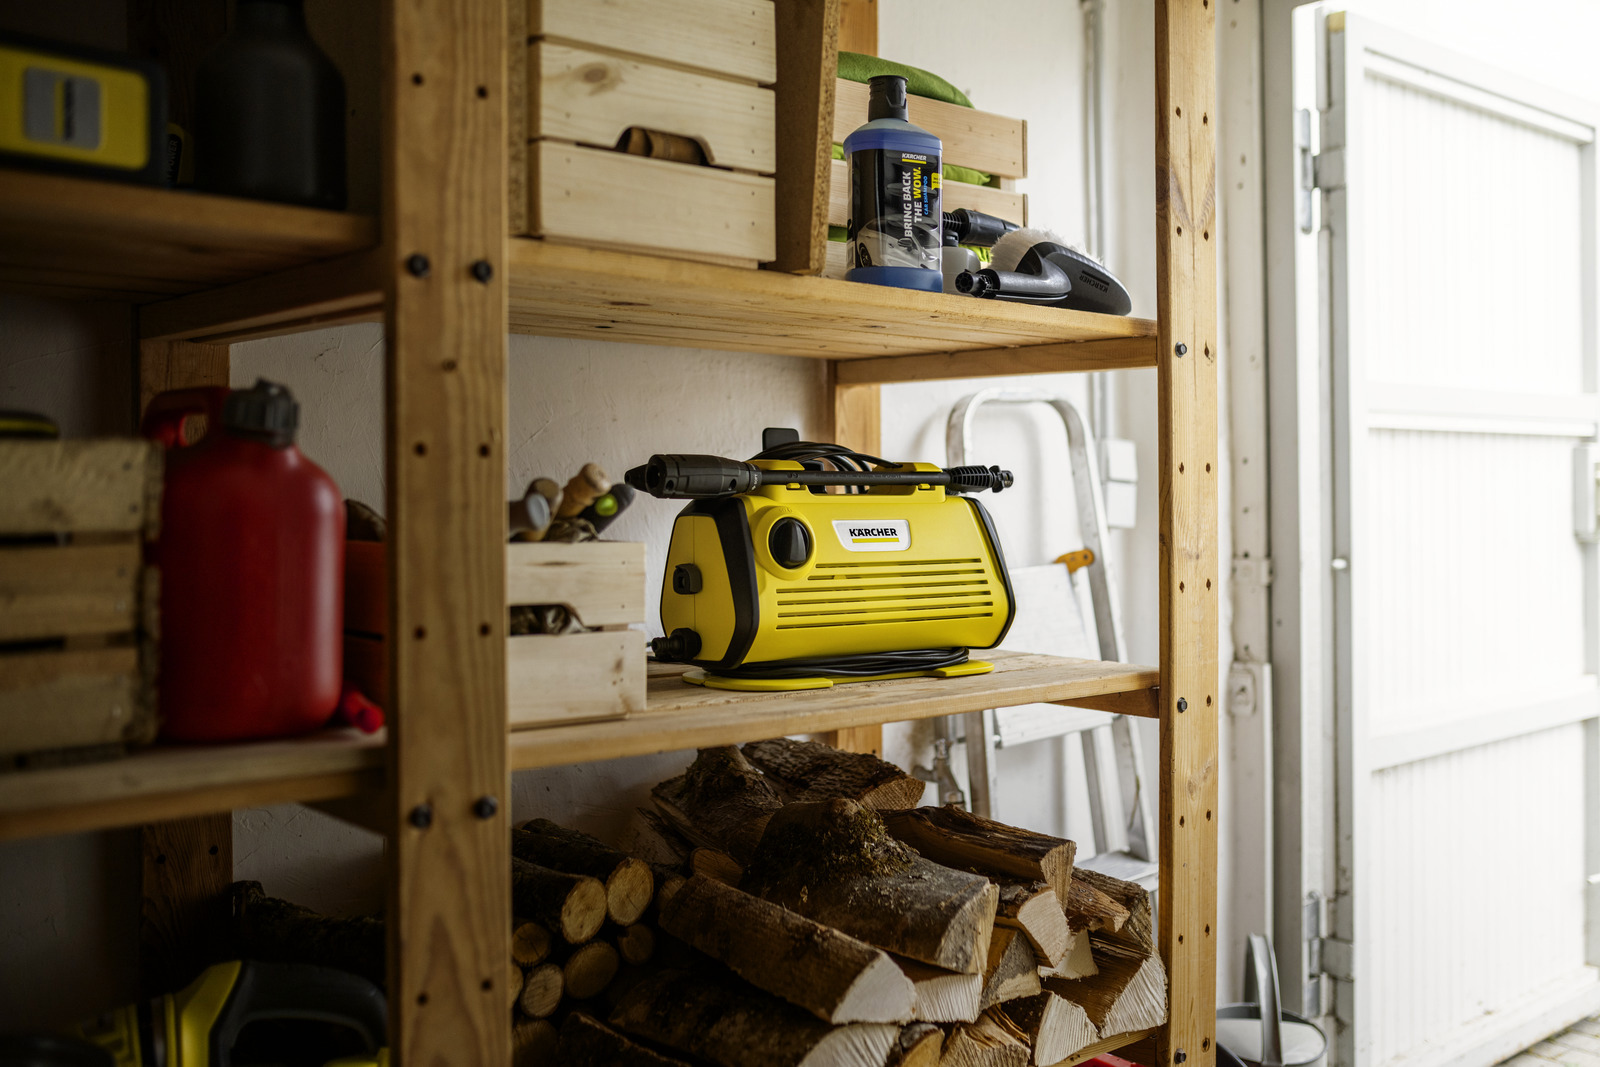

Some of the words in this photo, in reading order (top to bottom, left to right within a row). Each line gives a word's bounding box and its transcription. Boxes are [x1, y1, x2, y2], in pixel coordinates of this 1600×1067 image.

[901, 153, 927, 161] KÄRCHER
[902, 171, 912, 201] BACK
[913, 167, 922, 199] WOW.
[903, 203, 913, 238] BRING
[914, 201, 923, 223] THE
[1079, 275, 1109, 293] KÄRCHER
[849, 528, 898, 537] KÄRCHER
